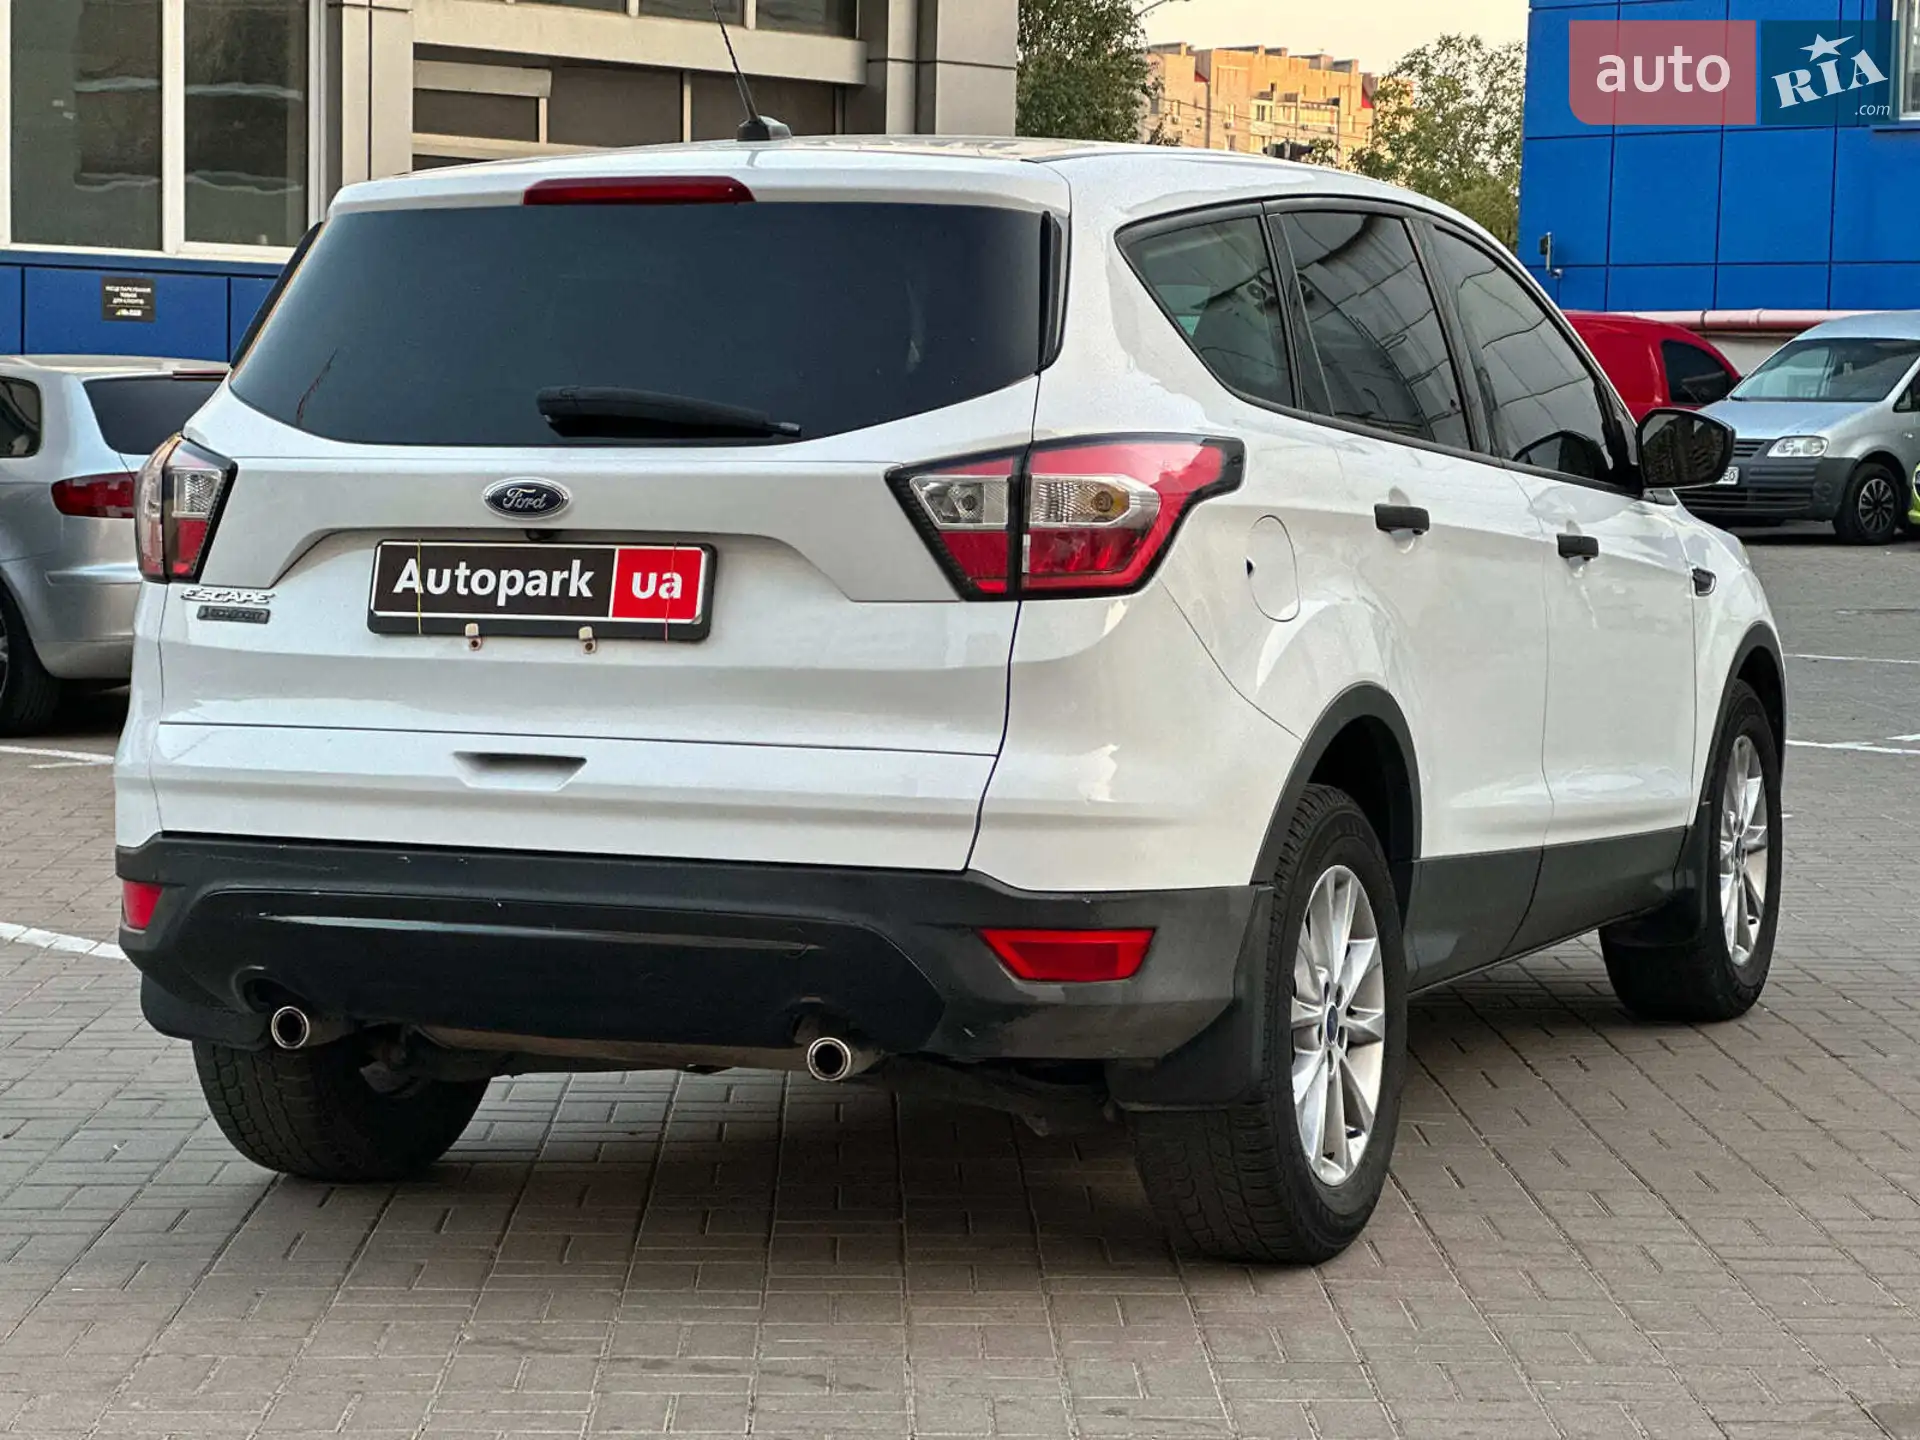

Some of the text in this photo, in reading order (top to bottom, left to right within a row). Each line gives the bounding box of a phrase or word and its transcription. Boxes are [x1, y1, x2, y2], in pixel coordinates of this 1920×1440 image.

[502, 487, 547, 509] Ford
[392, 558, 682, 607] Autopark ua
[181, 587, 276, 605] ESCAPE
